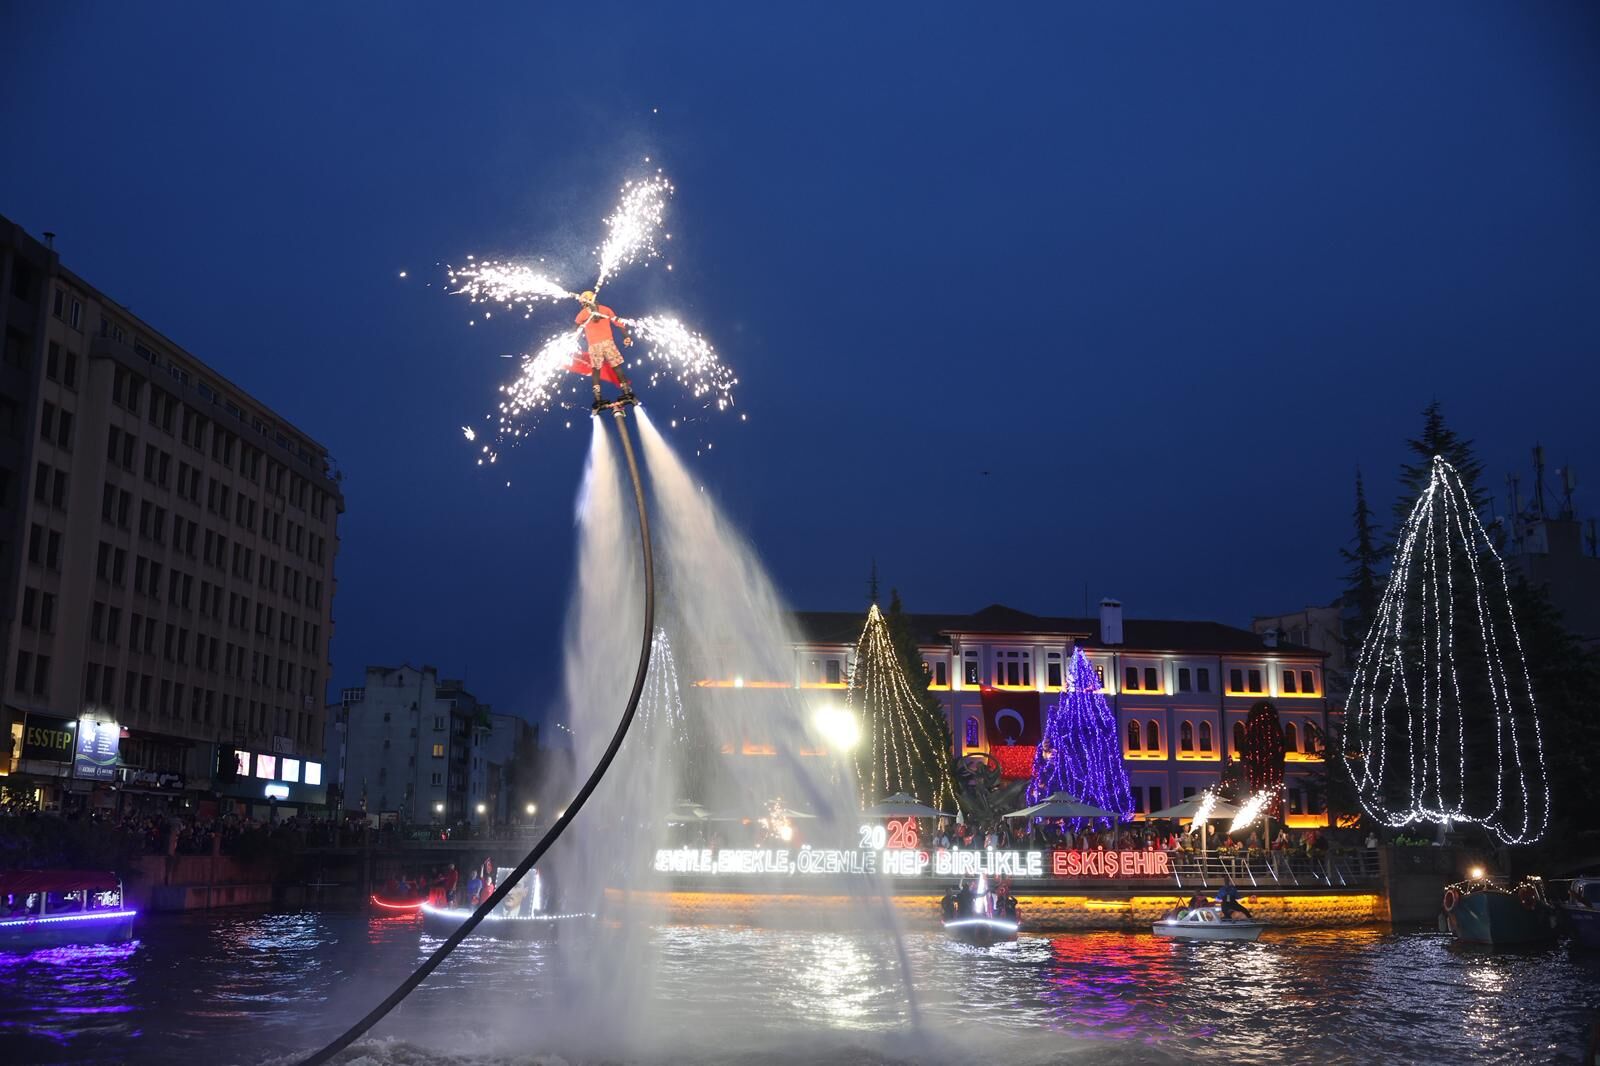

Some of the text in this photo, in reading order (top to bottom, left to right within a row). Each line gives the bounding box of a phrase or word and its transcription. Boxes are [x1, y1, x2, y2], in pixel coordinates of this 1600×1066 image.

[27, 727, 72, 750] ESSTEP
[859, 817, 918, 849] 2026
[797, 845, 876, 874] ÖZENLE
[882, 850, 930, 875] HEP
[935, 846, 1043, 875] BİRLİKLE
[1053, 846, 1170, 877] ESKİŞEHİR
